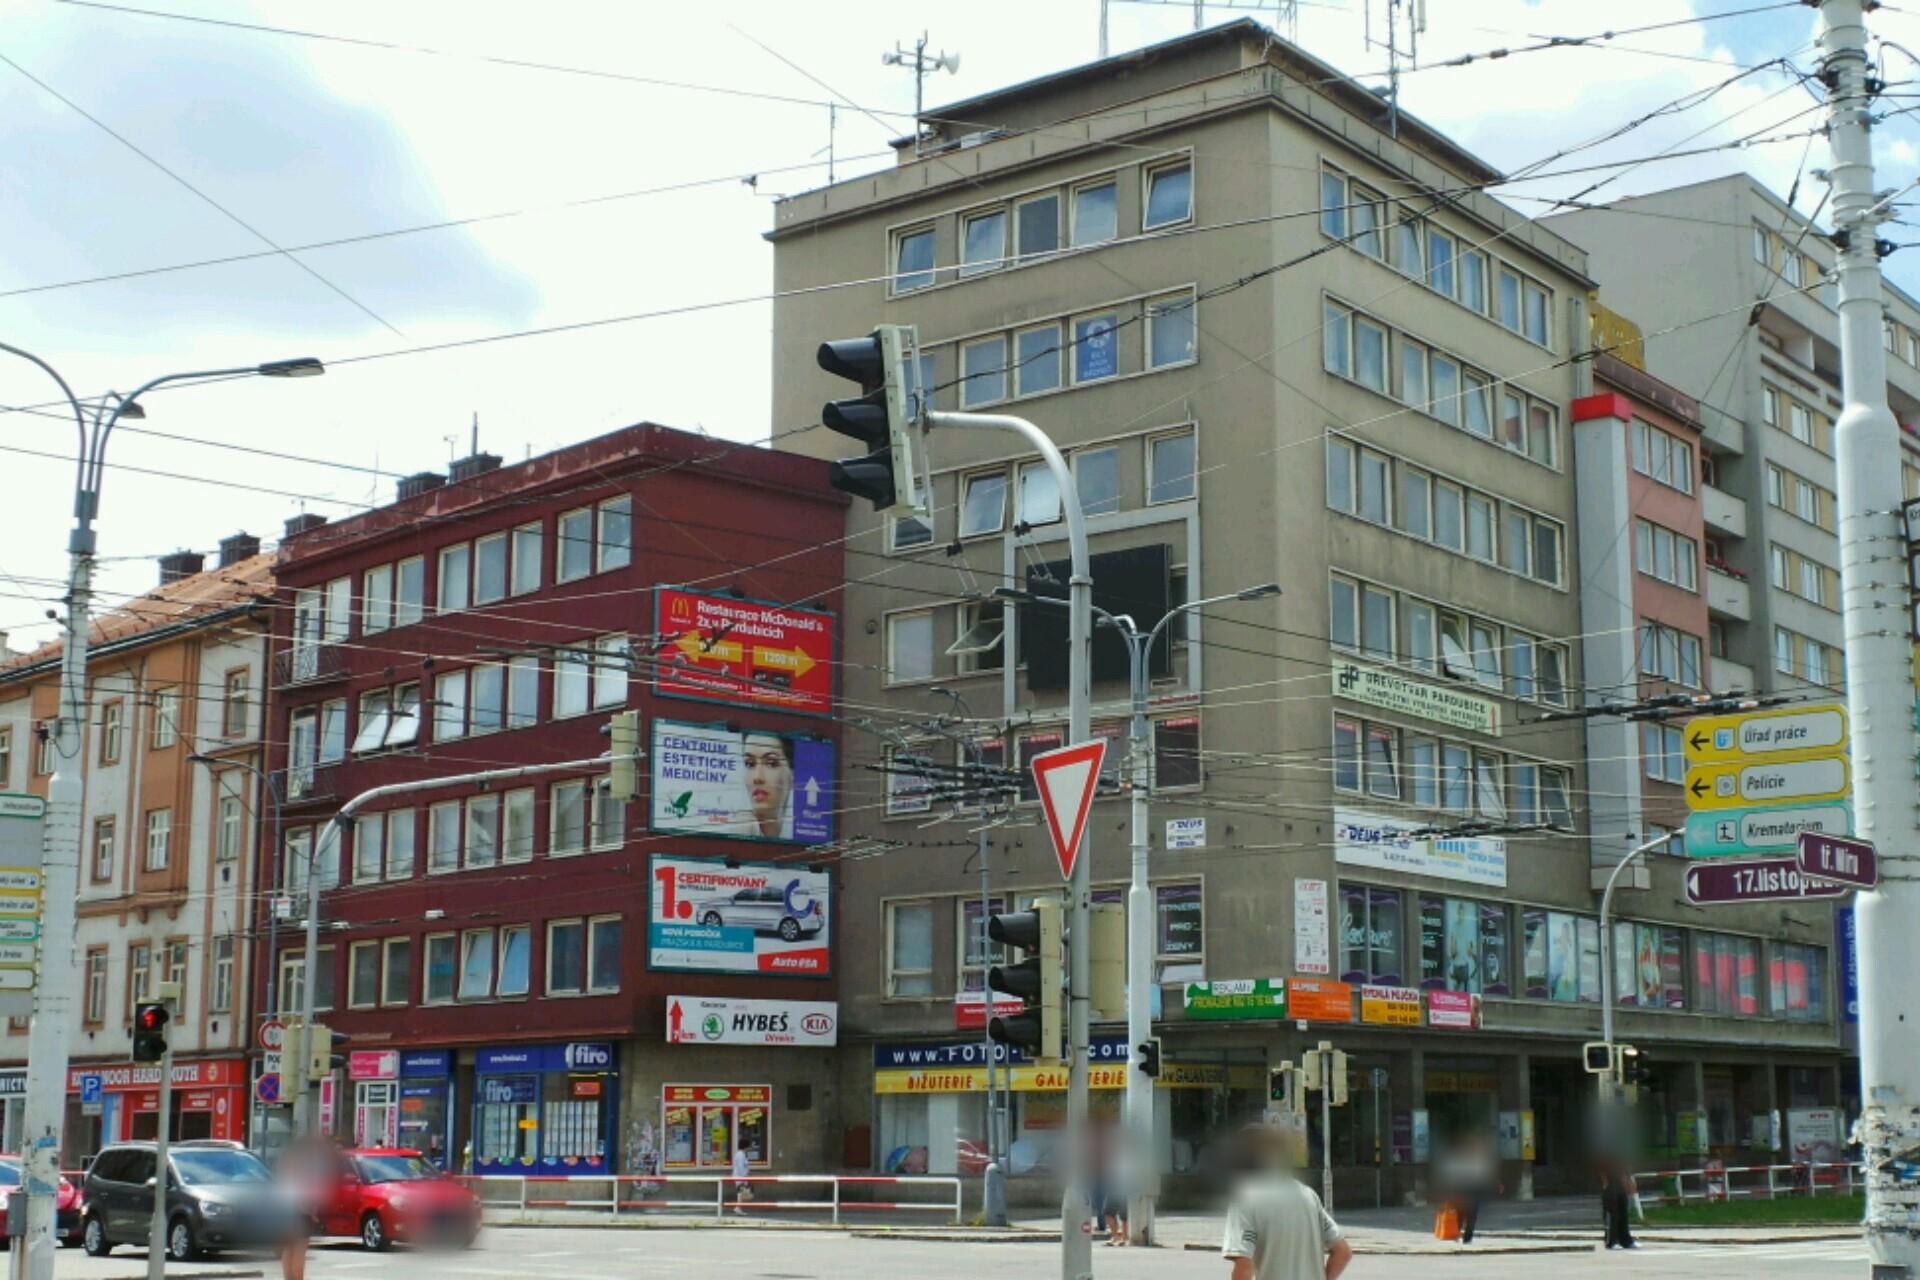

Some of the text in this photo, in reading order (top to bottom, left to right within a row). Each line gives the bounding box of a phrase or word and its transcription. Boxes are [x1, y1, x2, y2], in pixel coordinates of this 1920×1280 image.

[697, 600, 760, 622] Restaurace
[760, 610, 824, 632] McDonald's
[1431, 690, 1487, 714] PARDUBICE
[1744, 723, 1808, 744] Úřad práce
[663, 736, 728, 753] CENTRUM
[663, 752, 737, 771] ESTETICKÉ
[1746, 774, 1786, 791] Policie
[1746, 819, 1824, 838] Krematorium
[678, 872, 768, 888] CERTIFIKOVANÝ
[655, 866, 694, 920] 1.
[771, 957, 818, 969] Auto ESA
[732, 1011, 789, 1032] HYBEŠ
[806, 1018, 828, 1031] KIA
[575, 1045, 608, 1064] firo
[86, 1077, 98, 1095] P
[907, 1071, 973, 1089] BIŽUTERIE
[1035, 1069, 1125, 1088] GALTERIE
[486, 1080, 512, 1102] firo
